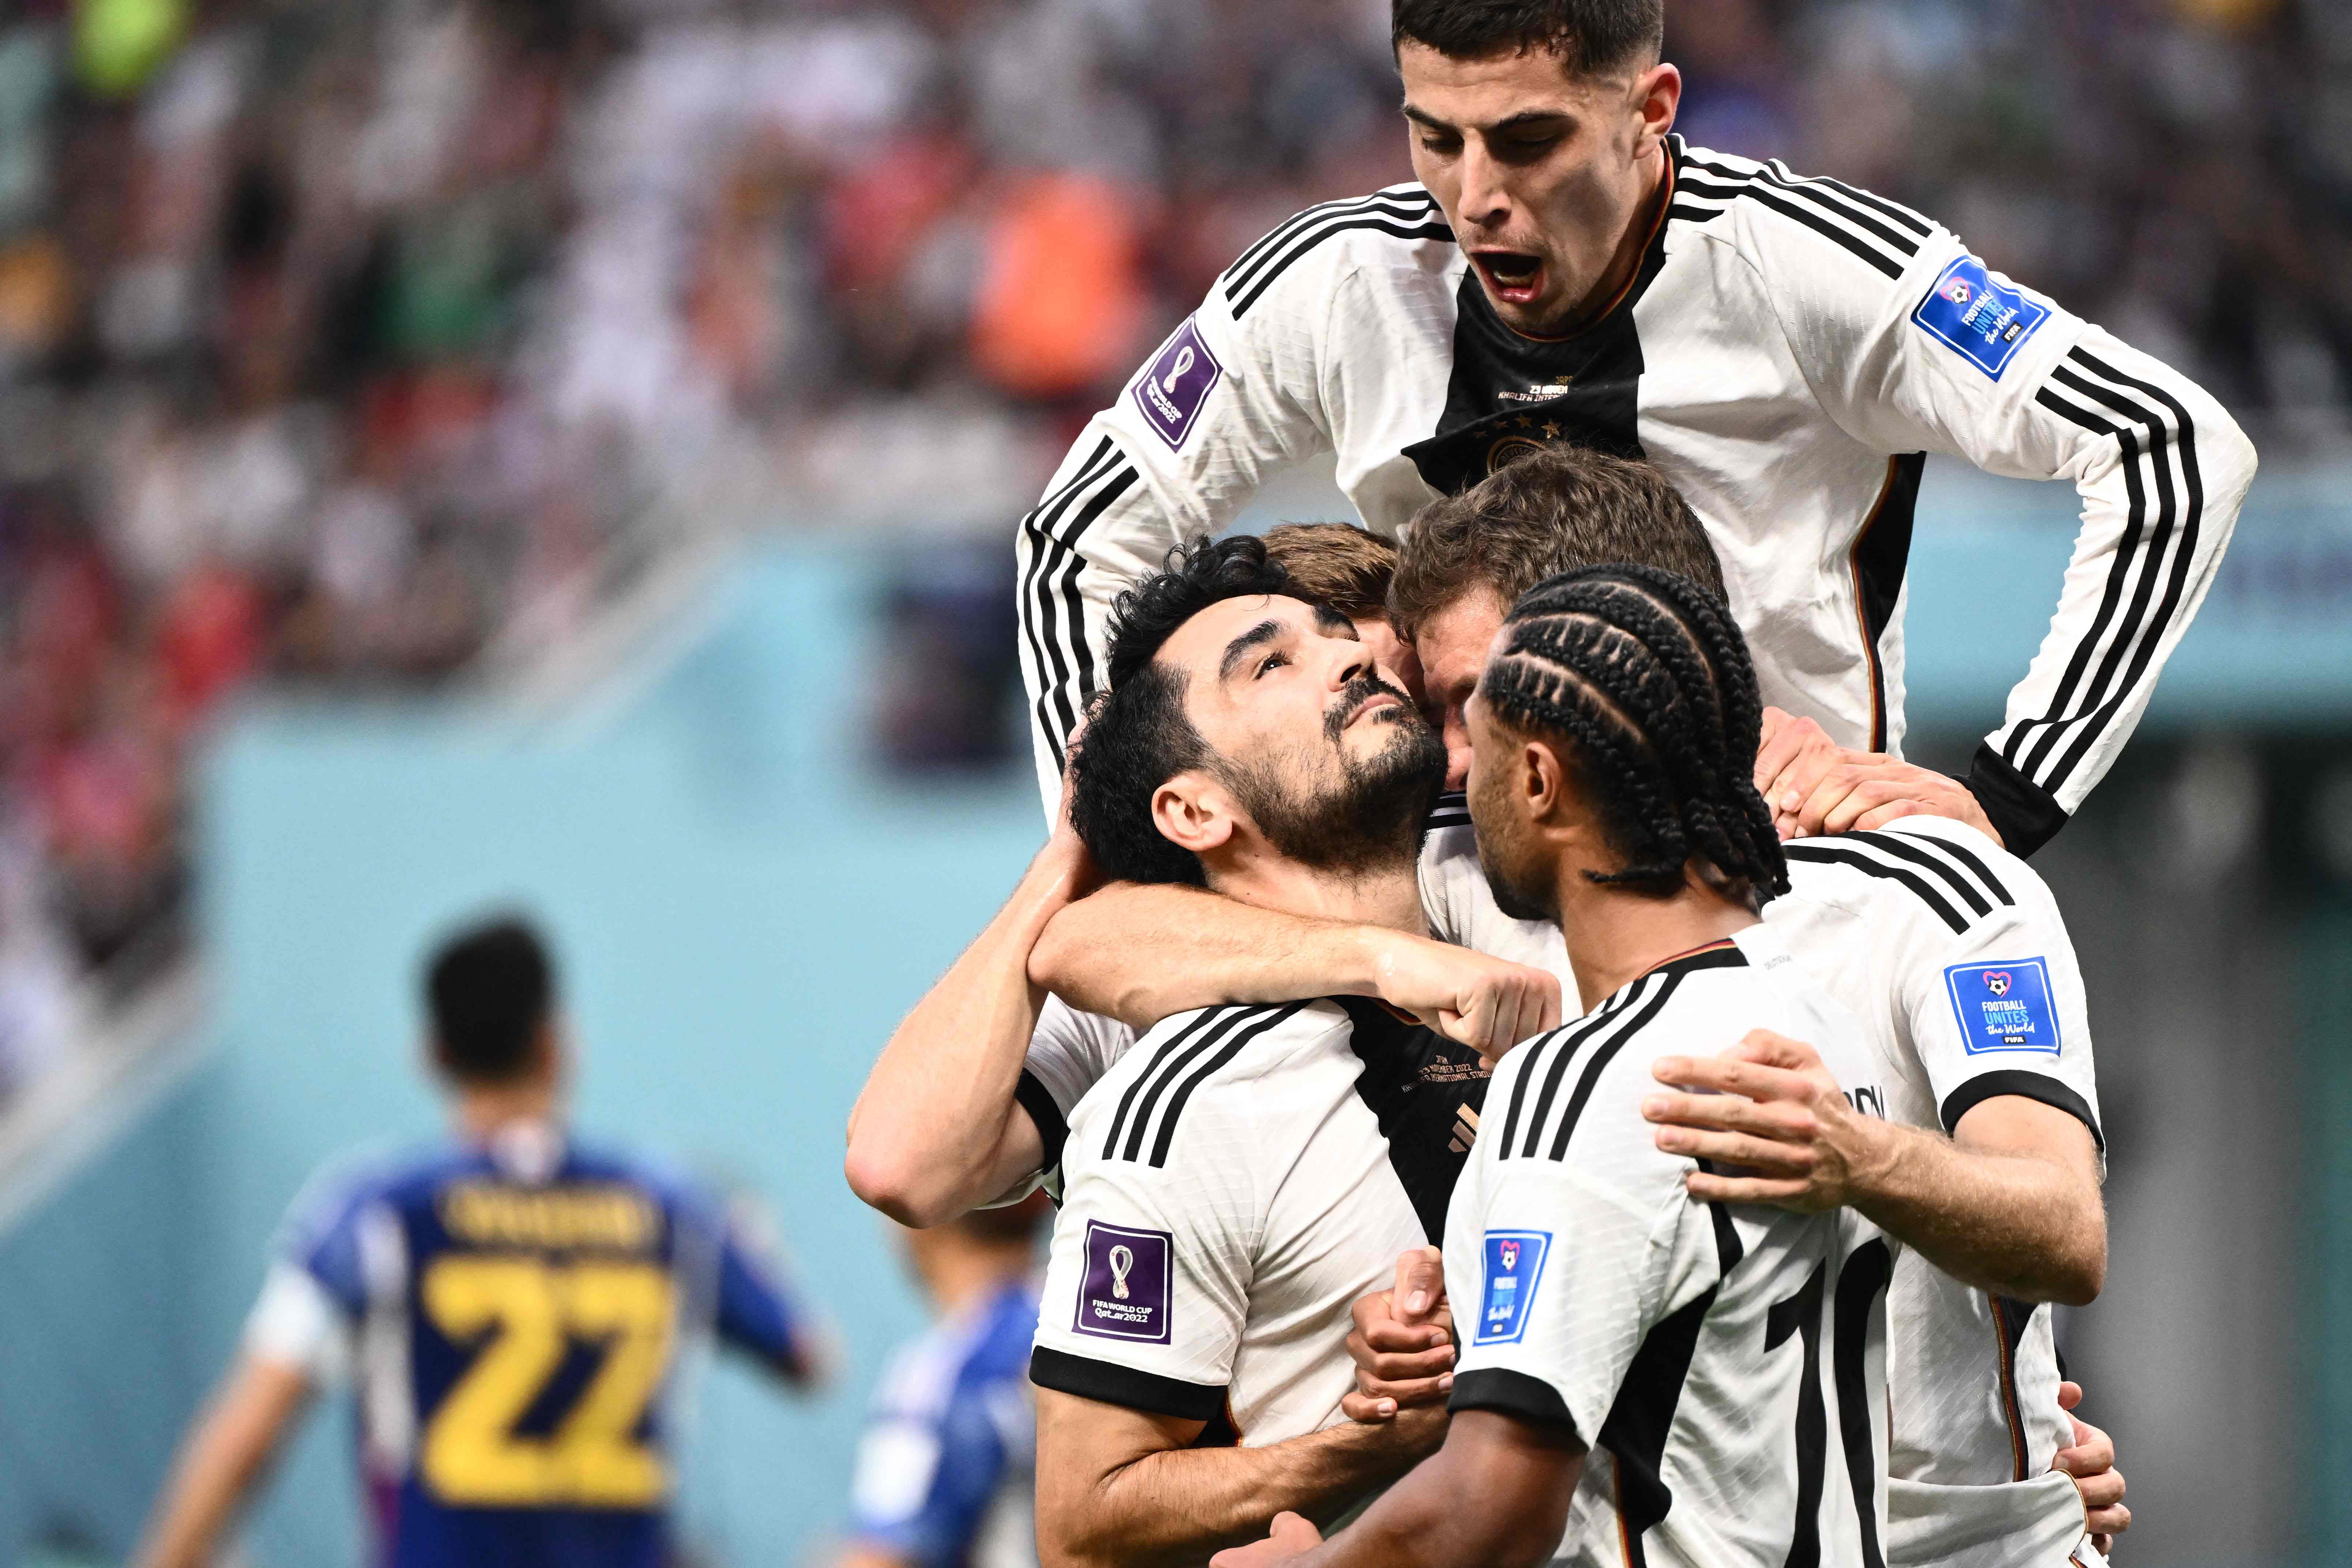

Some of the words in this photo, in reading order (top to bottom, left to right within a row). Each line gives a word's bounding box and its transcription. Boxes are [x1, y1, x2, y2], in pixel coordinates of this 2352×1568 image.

[1985, 329, 1999, 345] the
[2004, 324, 2021, 341] FIFA
[1498, 391, 1532, 401] KHALIFA
[1529, 385, 1541, 394] 23
[1982, 1000, 2027, 1012] FOOTBALL
[1984, 1009, 2029, 1024] UNITES
[1985, 1024, 2004, 1035] the
[2003, 1022, 2035, 1034] World
[1454, 1064, 1472, 1072] 2022
[1092, 1300, 1109, 1309] FIFA
[1108, 1302, 1135, 1313] WORLD
[424, 1256, 675, 1503] 22
